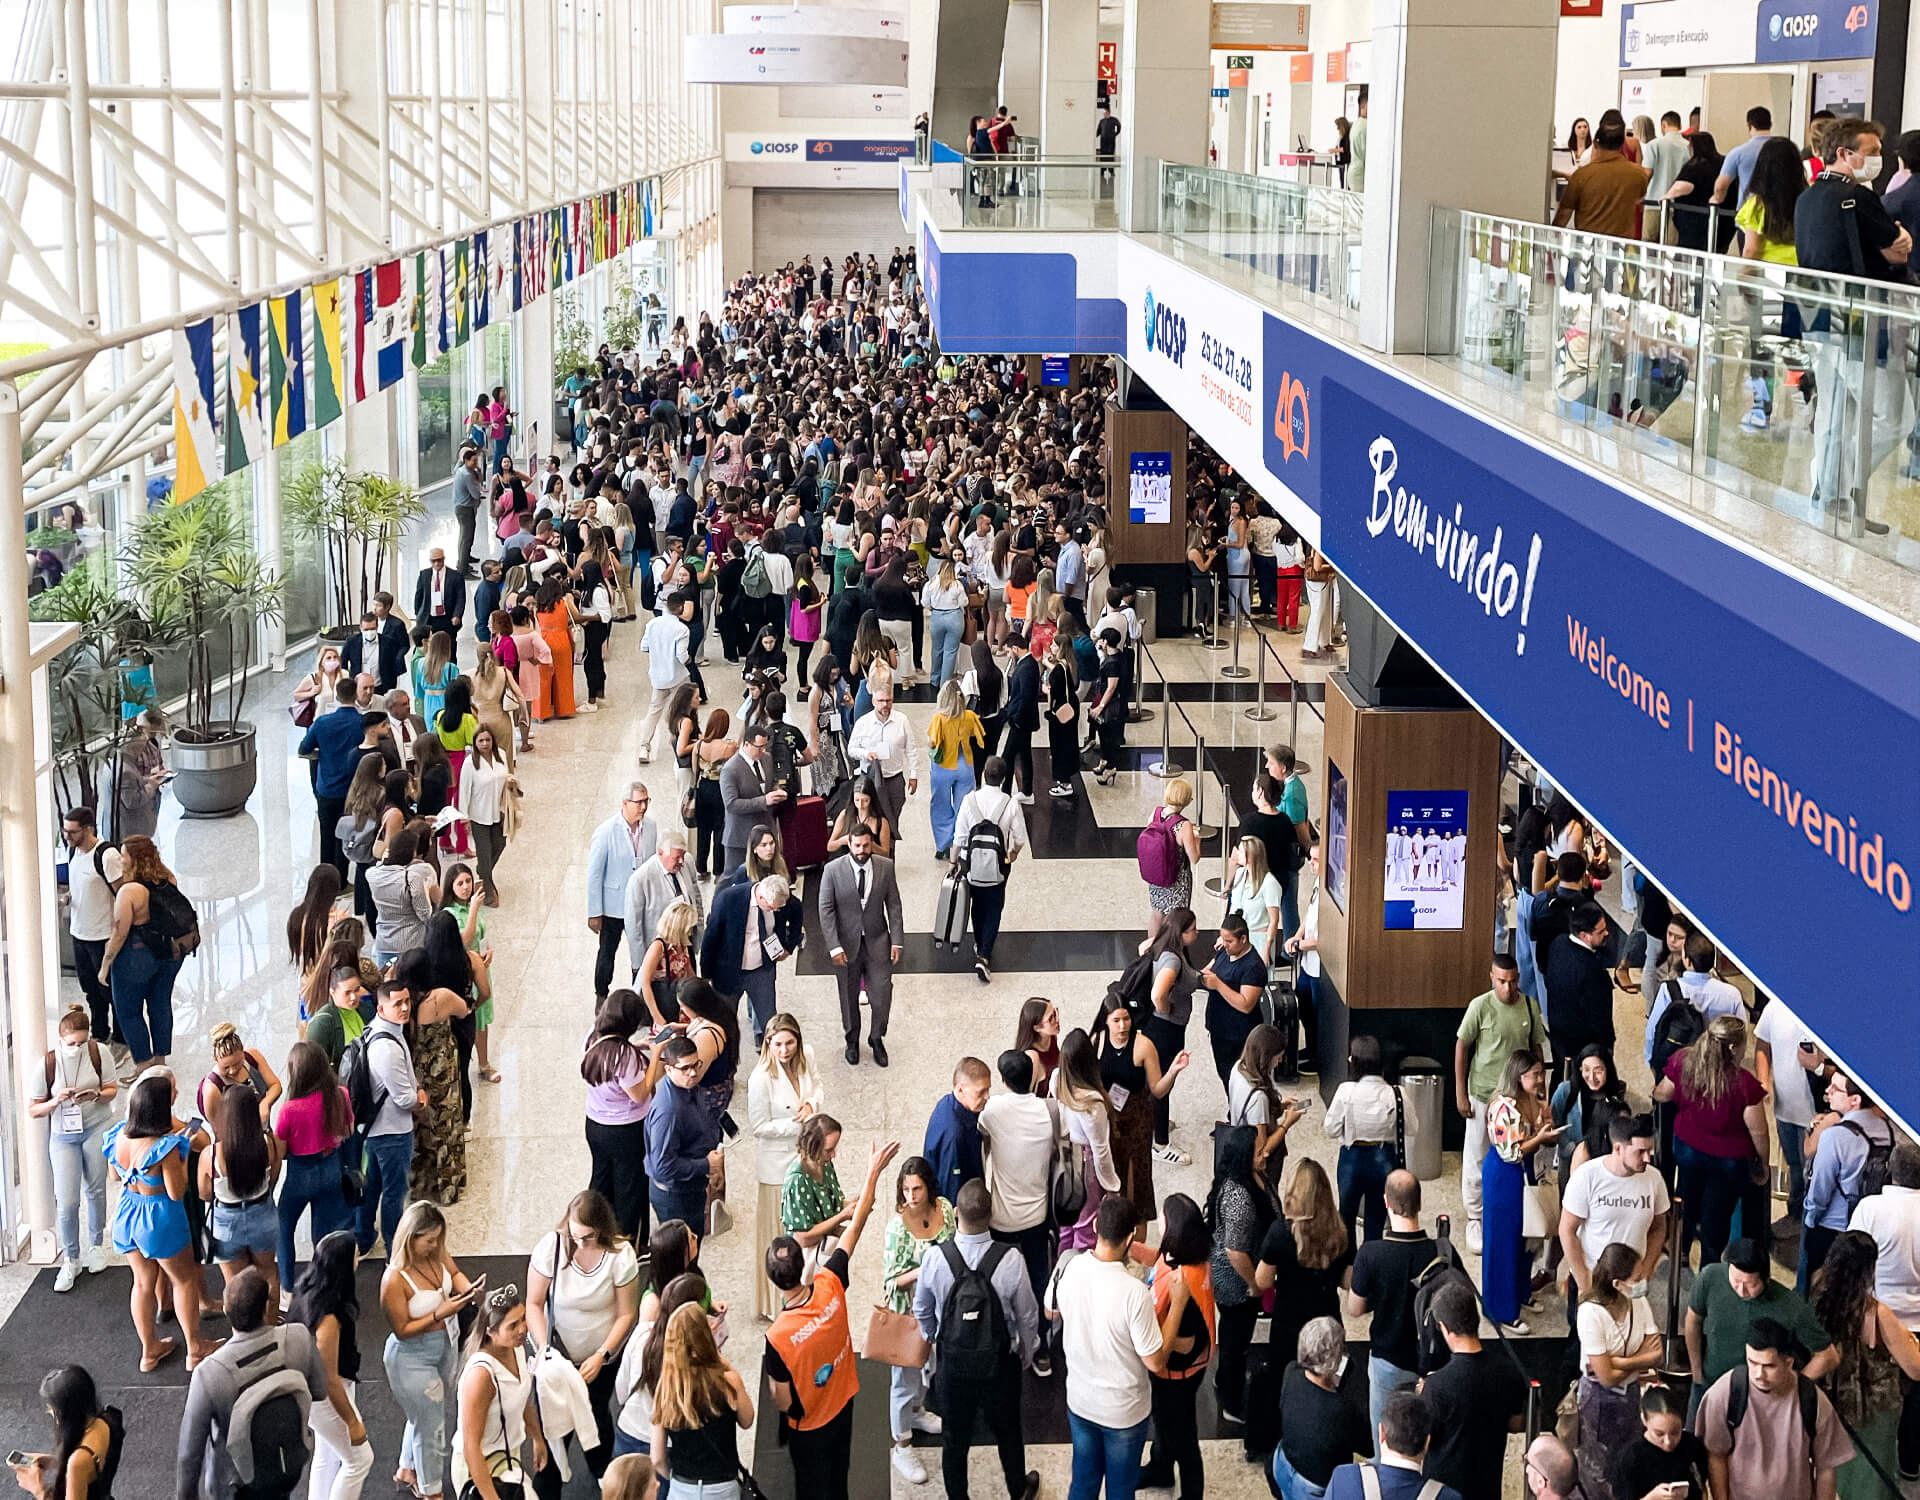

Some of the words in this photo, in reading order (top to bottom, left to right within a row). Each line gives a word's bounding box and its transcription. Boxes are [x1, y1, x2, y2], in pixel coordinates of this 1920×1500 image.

[1782, 14, 1819, 38] CIOSP
[1845, 5, 1868, 32] 40
[1099, 45, 1115, 62] H
[764, 143, 799, 153] CIOSP
[813, 142, 833, 154] 40
[1155, 302, 1187, 369] CIOSP
[1235, 369, 1240, 384] e
[1240, 357, 1252, 392] 28
[1236, 396, 1252, 426] 2023
[1274, 371, 1310, 464] 40
[1366, 435, 1542, 656] Bem-vindo!
[1567, 614, 1670, 729] Welcome
[1714, 721, 1911, 912] Bienvenido
[1598, 1195, 1639, 1209] Hurley
